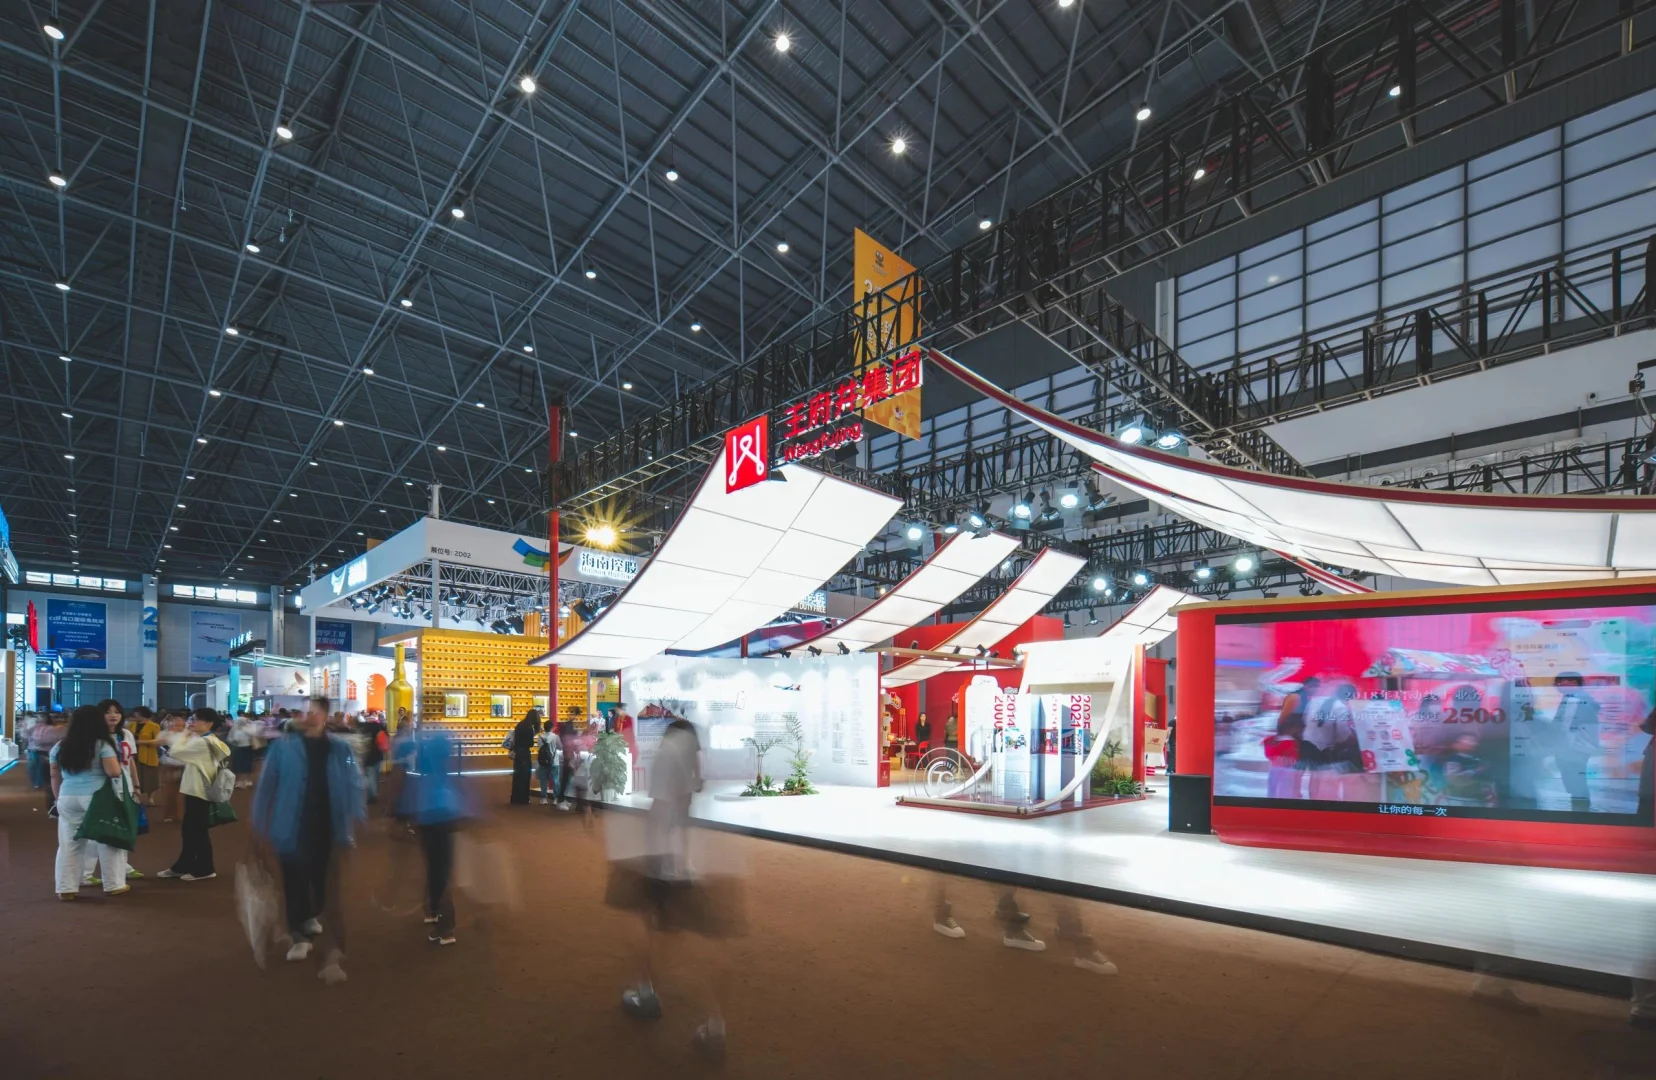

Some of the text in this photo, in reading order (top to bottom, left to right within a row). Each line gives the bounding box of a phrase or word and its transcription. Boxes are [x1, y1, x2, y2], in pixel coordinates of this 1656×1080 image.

[783, 351, 922, 438] 王府井集团
[784, 423, 862, 460] Wangfujing
[454, 550, 472, 559] 2D02
[582, 553, 637, 573] 海南控股
[581, 566, 606, 576] Hainan
[143, 606, 158, 625] 2
[799, 602, 813, 611] DUTY
[813, 604, 826, 614] FREE
[1006, 695, 1016, 728] 2014
[1070, 695, 1082, 729] 2021
[1442, 707, 1506, 724] 2500
[1378, 805, 1448, 817] 让你的每一次
